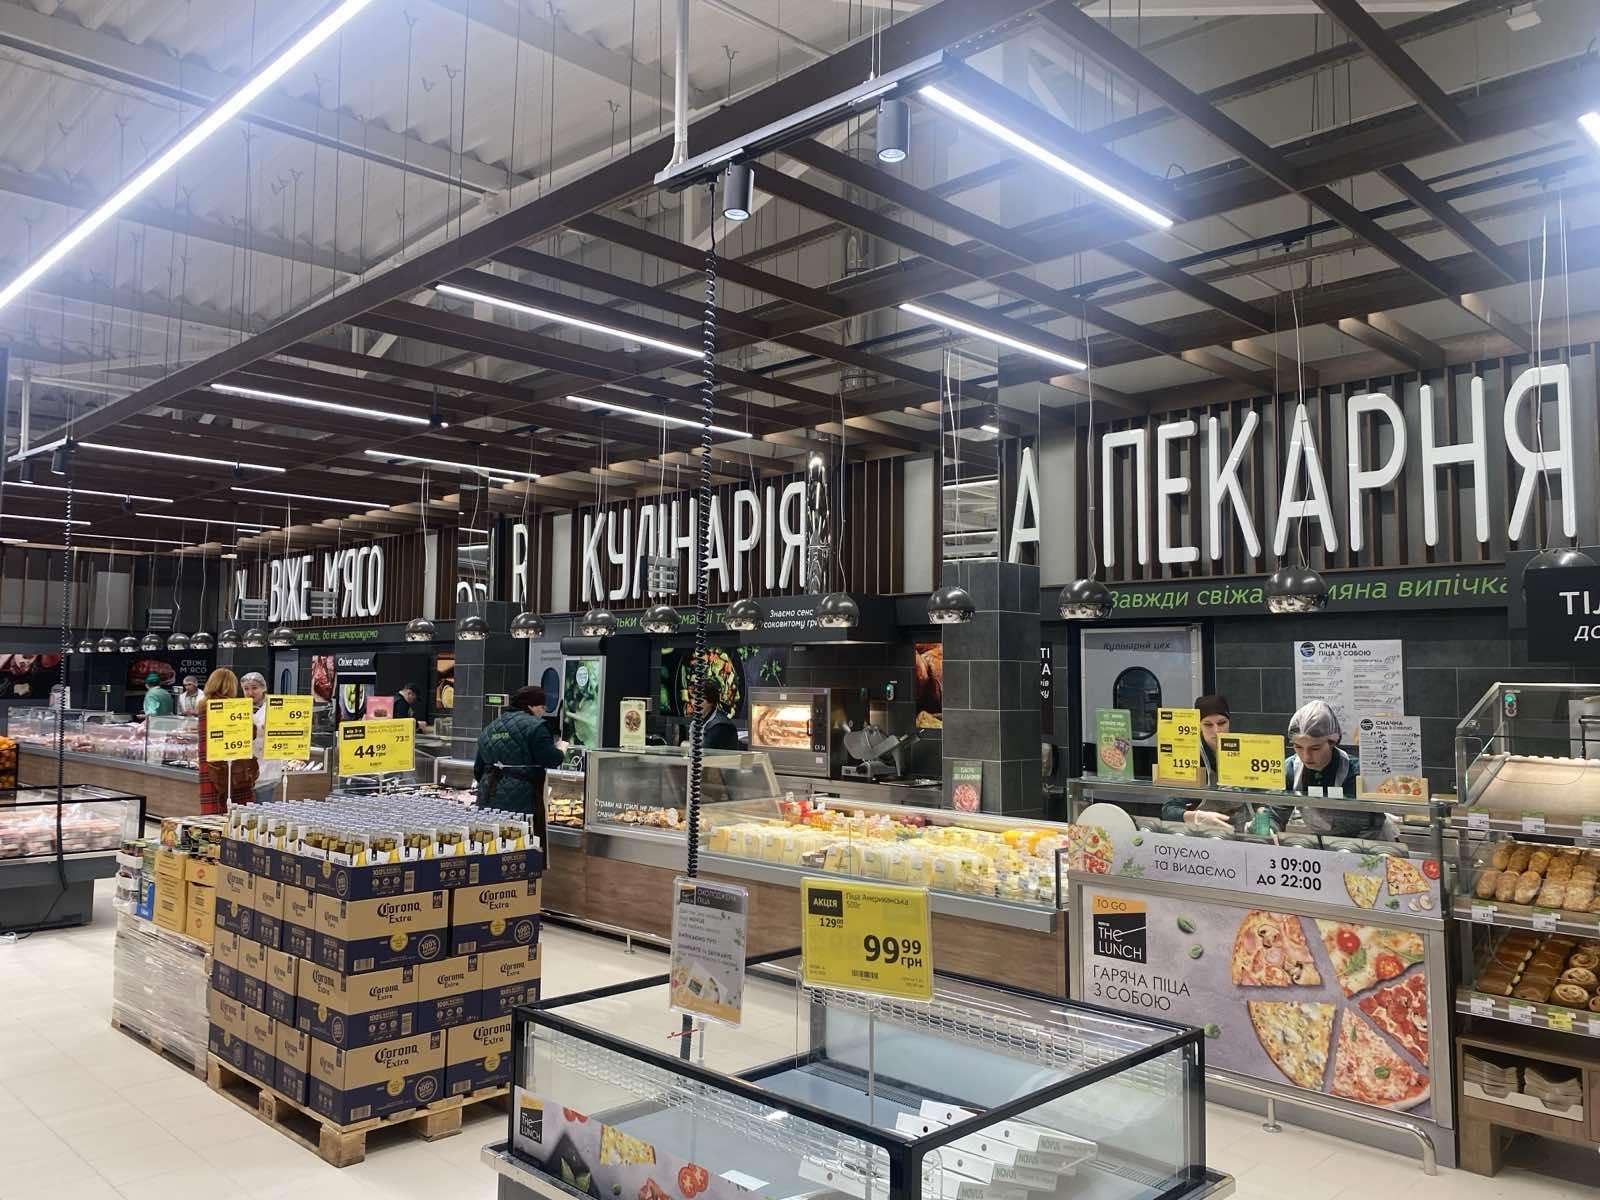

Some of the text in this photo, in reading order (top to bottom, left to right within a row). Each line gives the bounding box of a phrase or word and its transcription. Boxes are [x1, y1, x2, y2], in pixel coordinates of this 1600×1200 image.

[1102, 363, 1577, 568] ПЕКАРНЯ
[582, 481, 807, 603] КУЛІНАРІЯ
[268, 555, 314, 623] ВІЖЕ
[323, 545, 384, 619] М'ЯСО
[1112, 590, 1190, 610] Завжди
[1196, 585, 1264, 606] свіжа
[769, 608, 814, 619] Знаємо сенс
[763, 619, 805, 630] соковитому
[229, 713, 243, 721] 64
[289, 710, 302, 719] 69
[1178, 726, 1190, 735] 99
[224, 741, 243, 750] 169
[354, 745, 376, 758] 44
[1173, 759, 1191, 768] 119
[1251, 758, 1281, 772] 89 99
[1154, 844, 1210, 861] готуємо
[1154, 859, 1236, 879] та видаємо
[1269, 857, 1322, 875] з 09:00
[1280, 874, 1322, 891] 22:00
[478, 888, 518, 904] Corona
[813, 897, 838, 908] АКЦІЯ
[377, 902, 422, 918] Corona
[489, 902, 509, 910] Extra
[1097, 898, 1127, 912] TO GO
[389, 915, 412, 924] Extra
[819, 917, 837, 929] 129
[421, 938, 436, 950] 100%
[863, 934, 922, 964] 99 99
[1098, 940, 1142, 960] LUNCH
[500, 961, 526, 974] Corona
[901, 956, 923, 969] грн
[437, 971, 465, 985] Corona
[1093, 964, 1191, 997] ГАРЯЧА ПІЦА
[369, 984, 399, 997] Corona
[1106, 985, 1171, 1011] СОБОЮ
[473, 1023, 511, 1041] Corona
[483, 1036, 504, 1047] Extra
[375, 1043, 418, 1064] Corona
[386, 1058, 409, 1069] Extra
[418, 1081, 434, 1093] 100%
